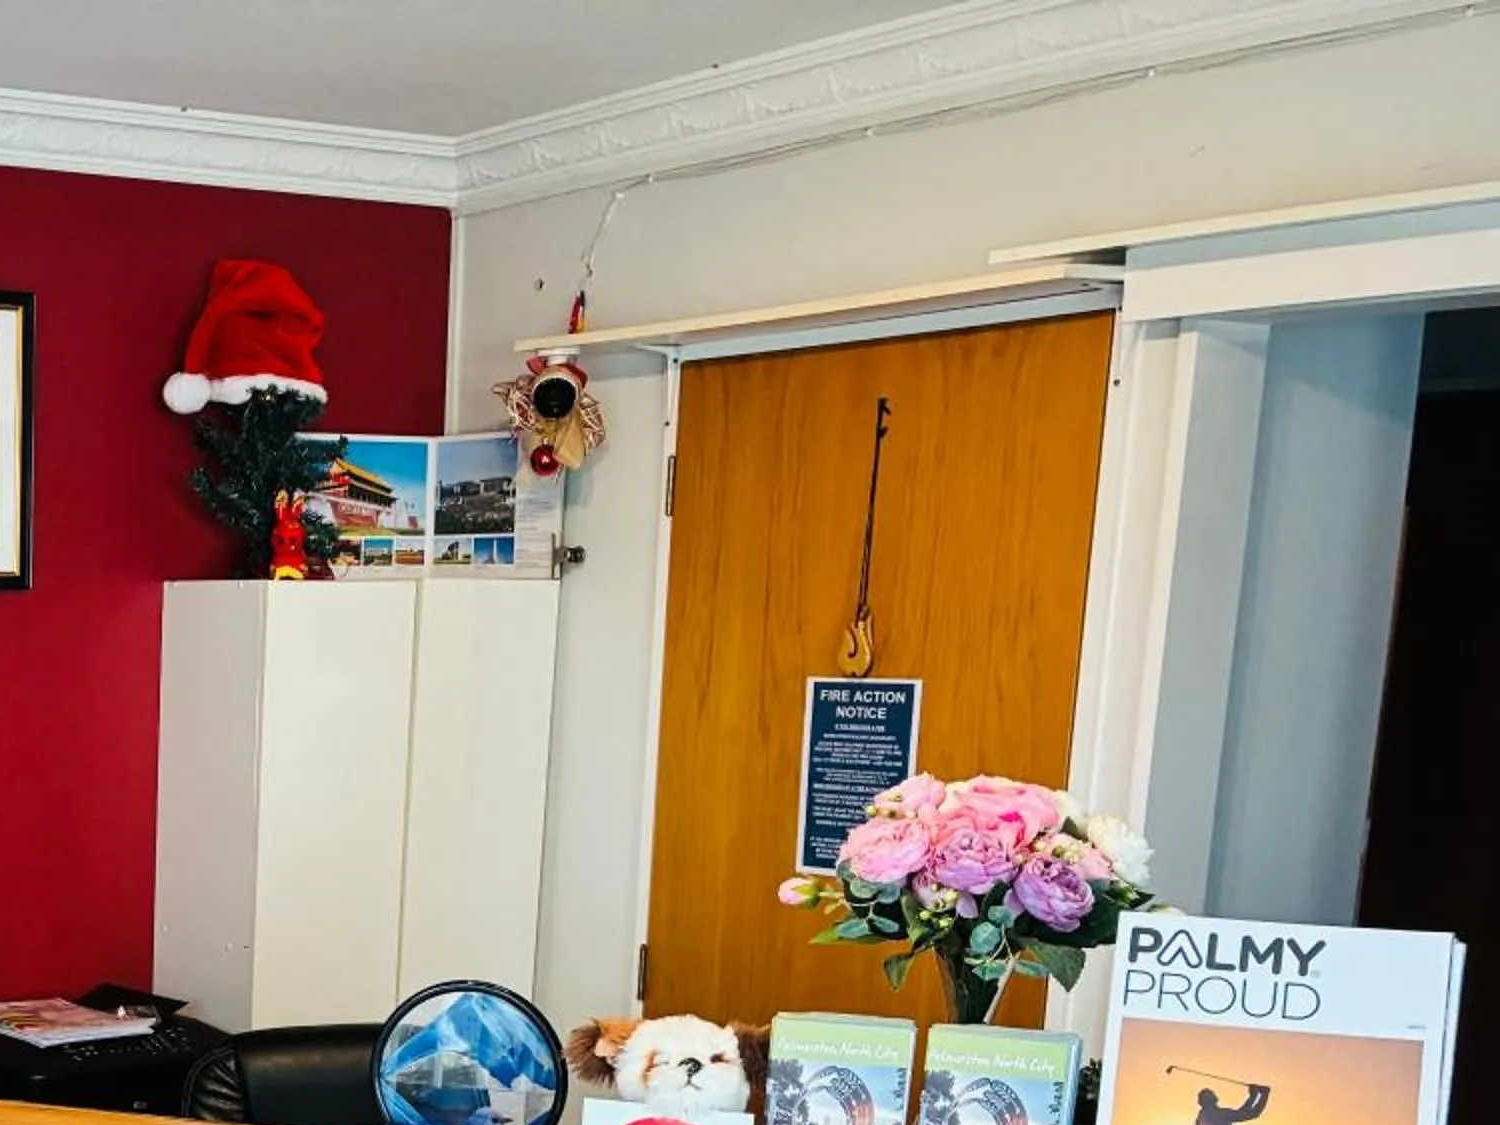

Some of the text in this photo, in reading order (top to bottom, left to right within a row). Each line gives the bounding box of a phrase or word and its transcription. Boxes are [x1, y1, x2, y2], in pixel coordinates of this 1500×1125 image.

[820, 690, 906, 704] FIRE ACTION
[836, 706, 887, 719] NOTICE
[1128, 927, 1327, 977] PALMY
[1123, 969, 1321, 1021] PROUD
[841, 1040, 871, 1057] North
[875, 1043, 900, 1061] City
[993, 1052, 1028, 1070] North
[1030, 1057, 1056, 1078] City
